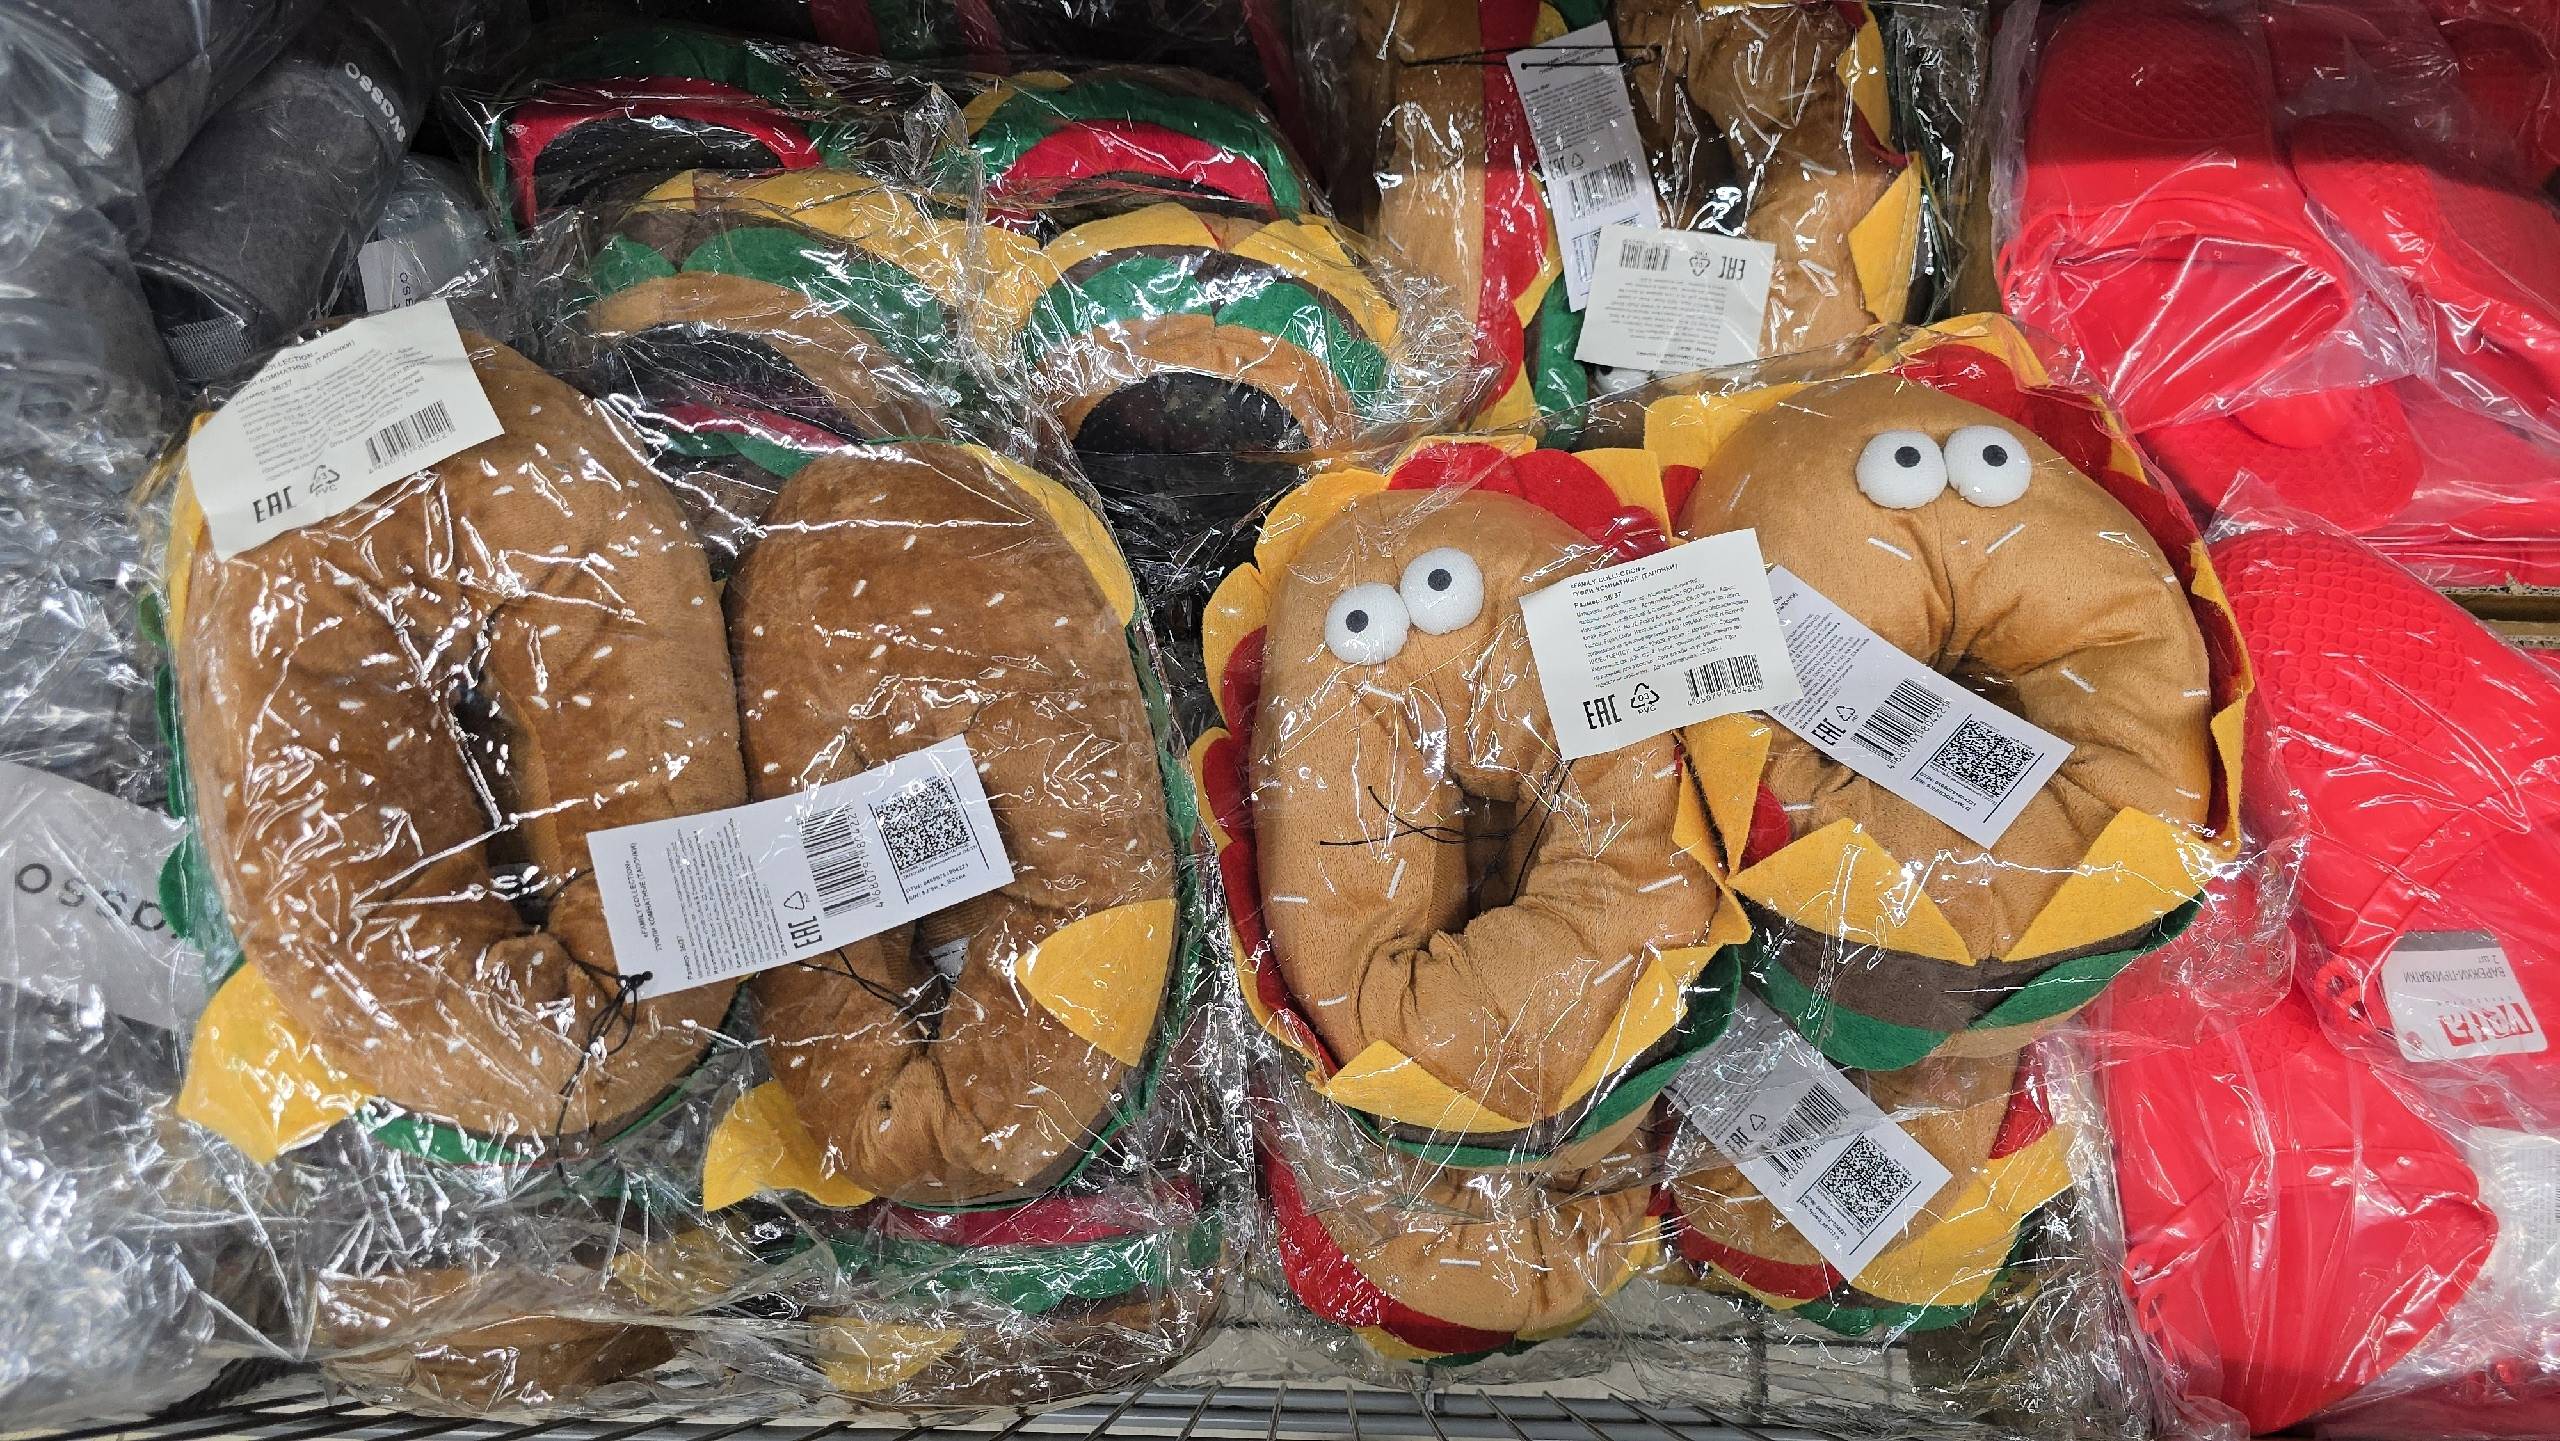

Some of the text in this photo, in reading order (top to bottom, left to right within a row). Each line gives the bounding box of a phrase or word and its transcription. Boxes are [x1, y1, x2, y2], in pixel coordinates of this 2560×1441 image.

[1718, 256, 1747, 281] EAC
[252, 486, 297, 524] EAC
[1583, 694, 1623, 730] EAC
[1811, 717, 1847, 747] EAC
[794, 915, 823, 949] EAC
[2403, 966, 2507, 984] ВАРЕЖКИ-ПРИХВАТКИ
